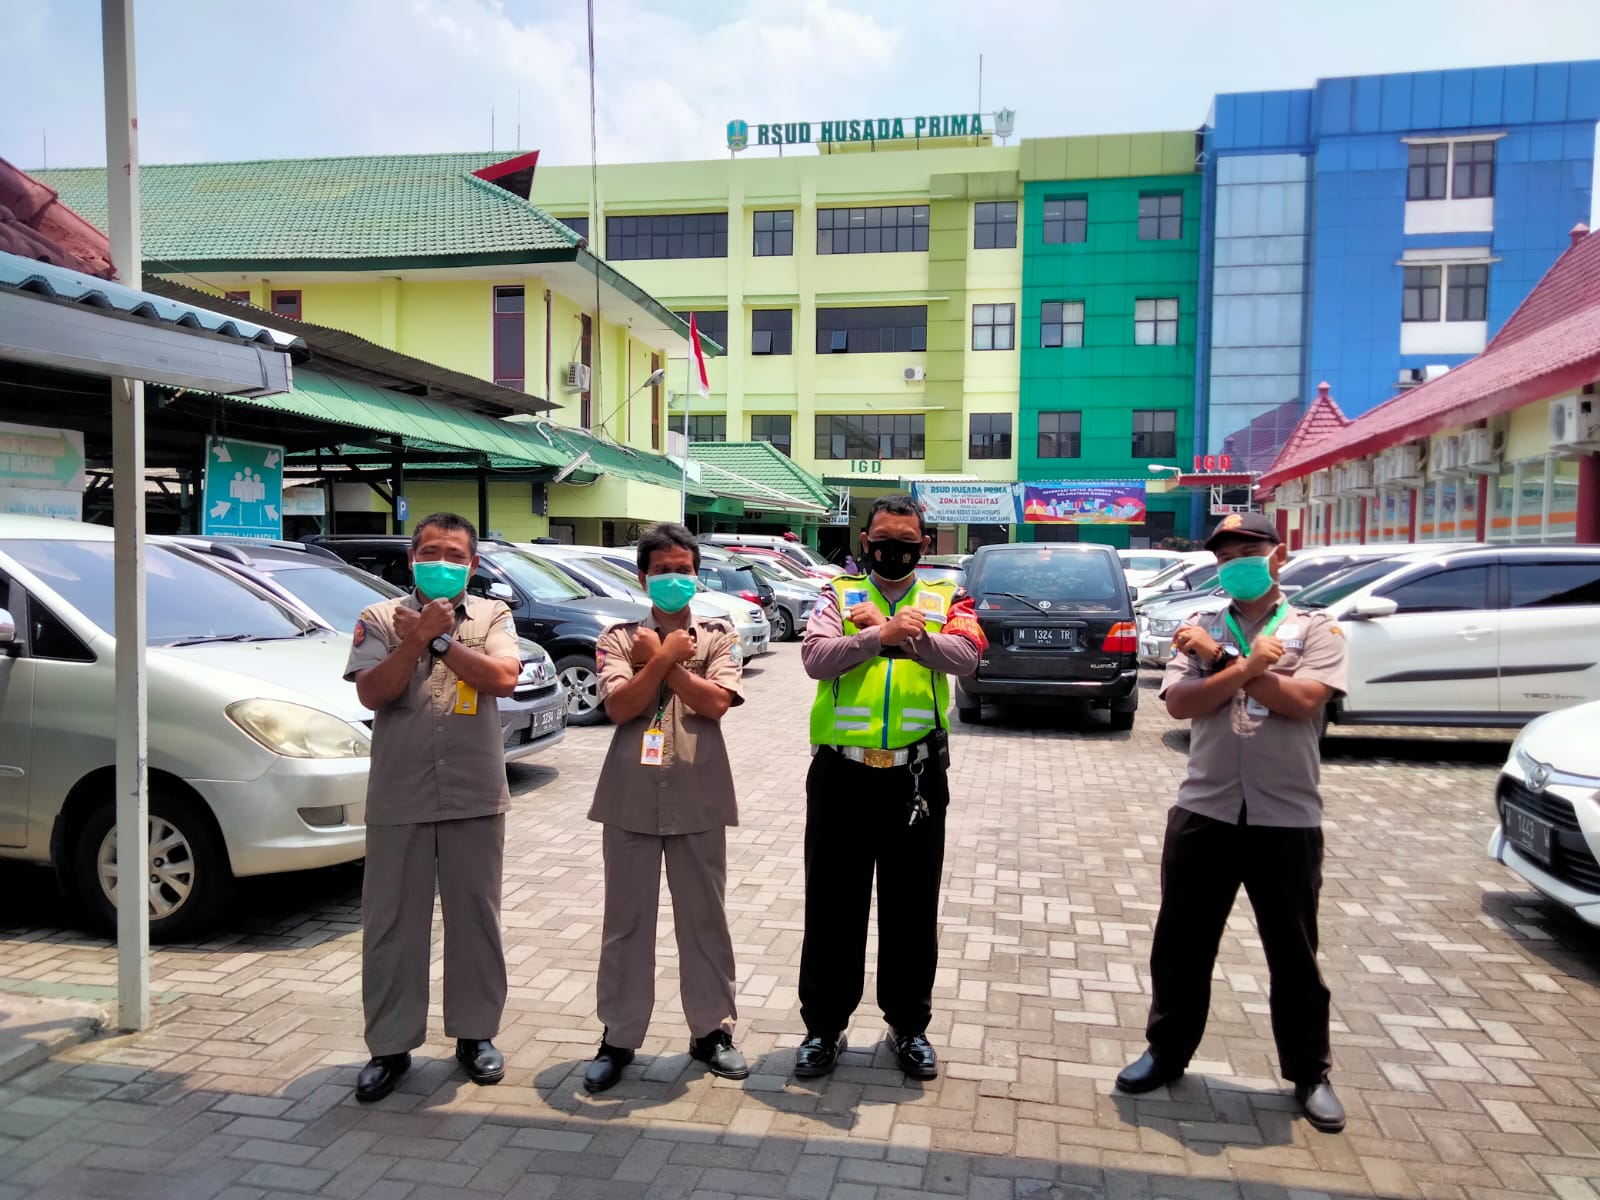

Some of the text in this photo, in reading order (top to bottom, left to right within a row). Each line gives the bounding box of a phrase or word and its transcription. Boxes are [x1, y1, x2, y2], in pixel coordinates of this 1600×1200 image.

[757, 113, 983, 145] RSUD HUSADA PRIMA
[850, 459, 882, 474] IGD
[1194, 455, 1231, 471] IGD
[939, 497, 999, 505] ZONA INTEGRITAS
[400, 503, 407, 514] P
[1019, 629, 1071, 640] N 1324 TR
